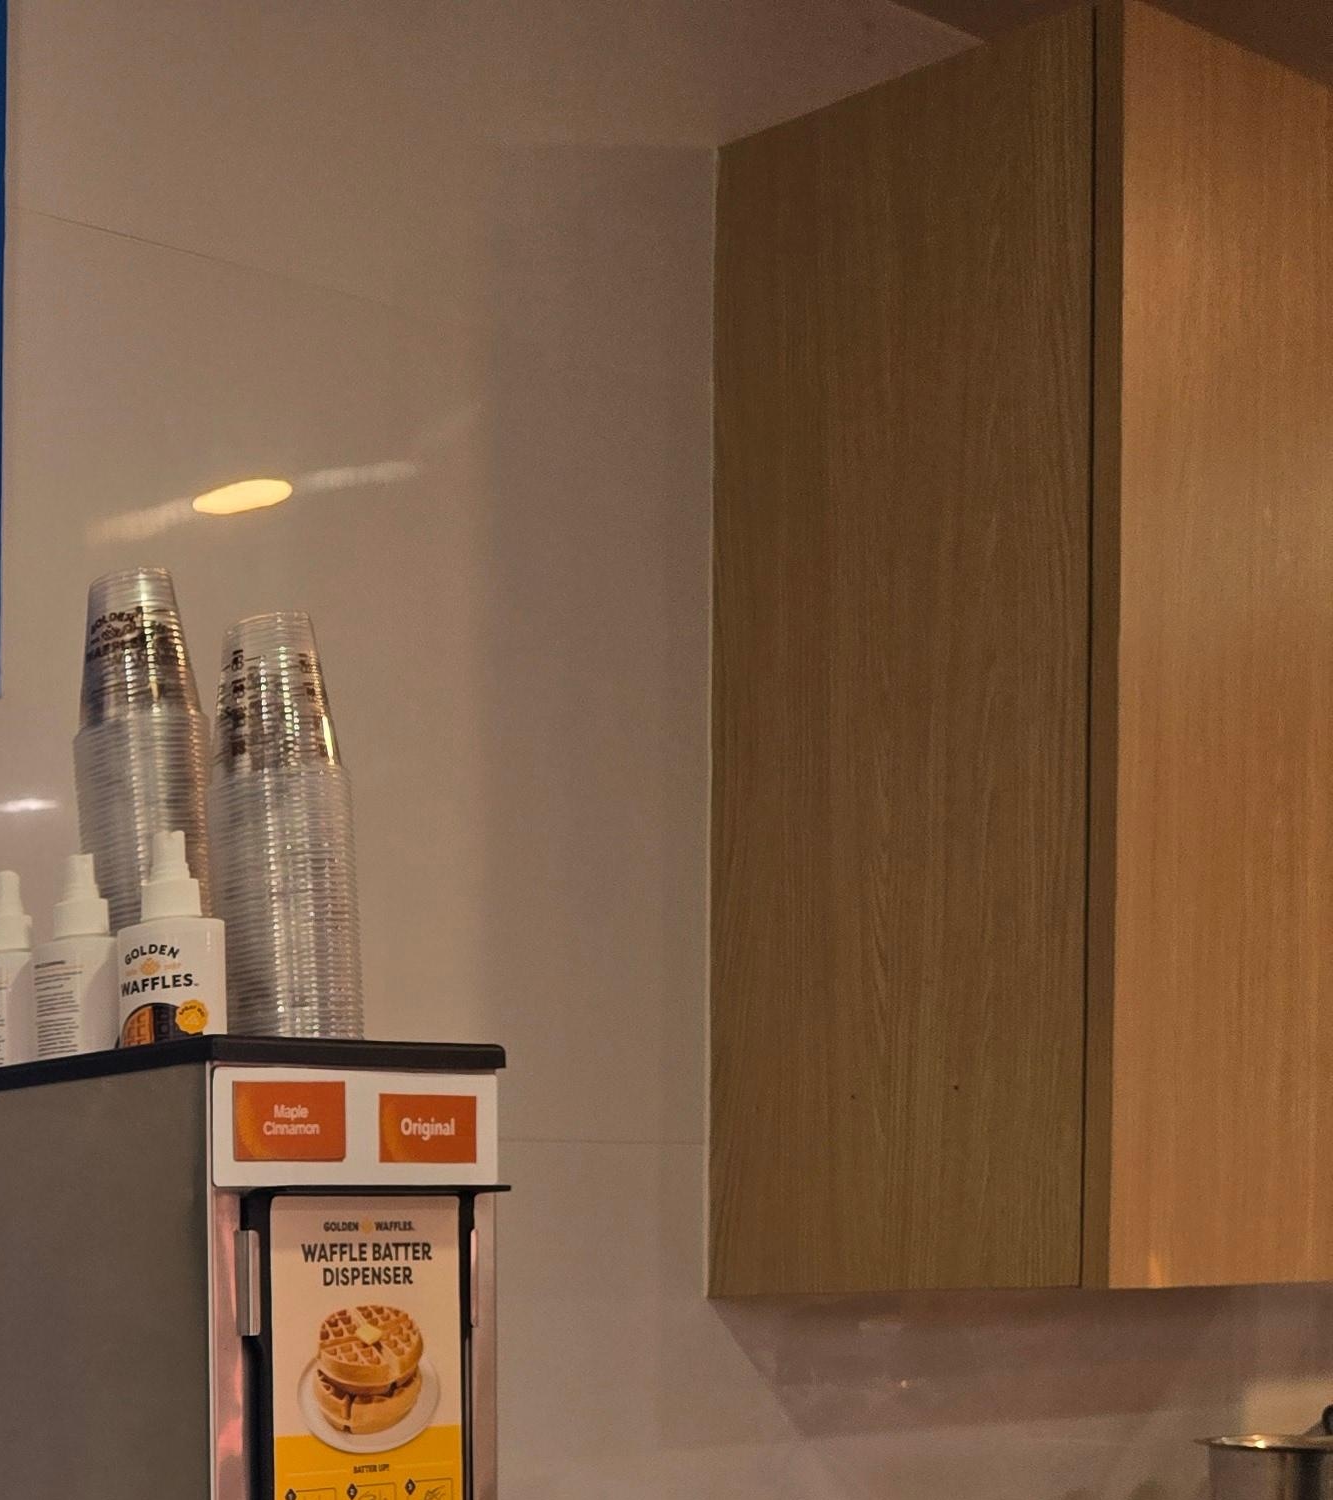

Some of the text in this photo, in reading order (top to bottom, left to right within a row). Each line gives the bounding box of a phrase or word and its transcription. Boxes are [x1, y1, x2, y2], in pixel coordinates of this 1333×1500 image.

[125, 944, 180, 966] GOLDEN
[121, 973, 194, 998] WAFFLES
[273, 1104, 309, 1121] Maple
[263, 1121, 321, 1136] Cinnamon
[400, 1118, 456, 1141] Original
[323, 1221, 359, 1232] GOLDEN
[301, 1242, 433, 1263] WAFFLE BATTER
[323, 1266, 414, 1287] DISPENSER
[354, 1465, 377, 1474] BATTER
